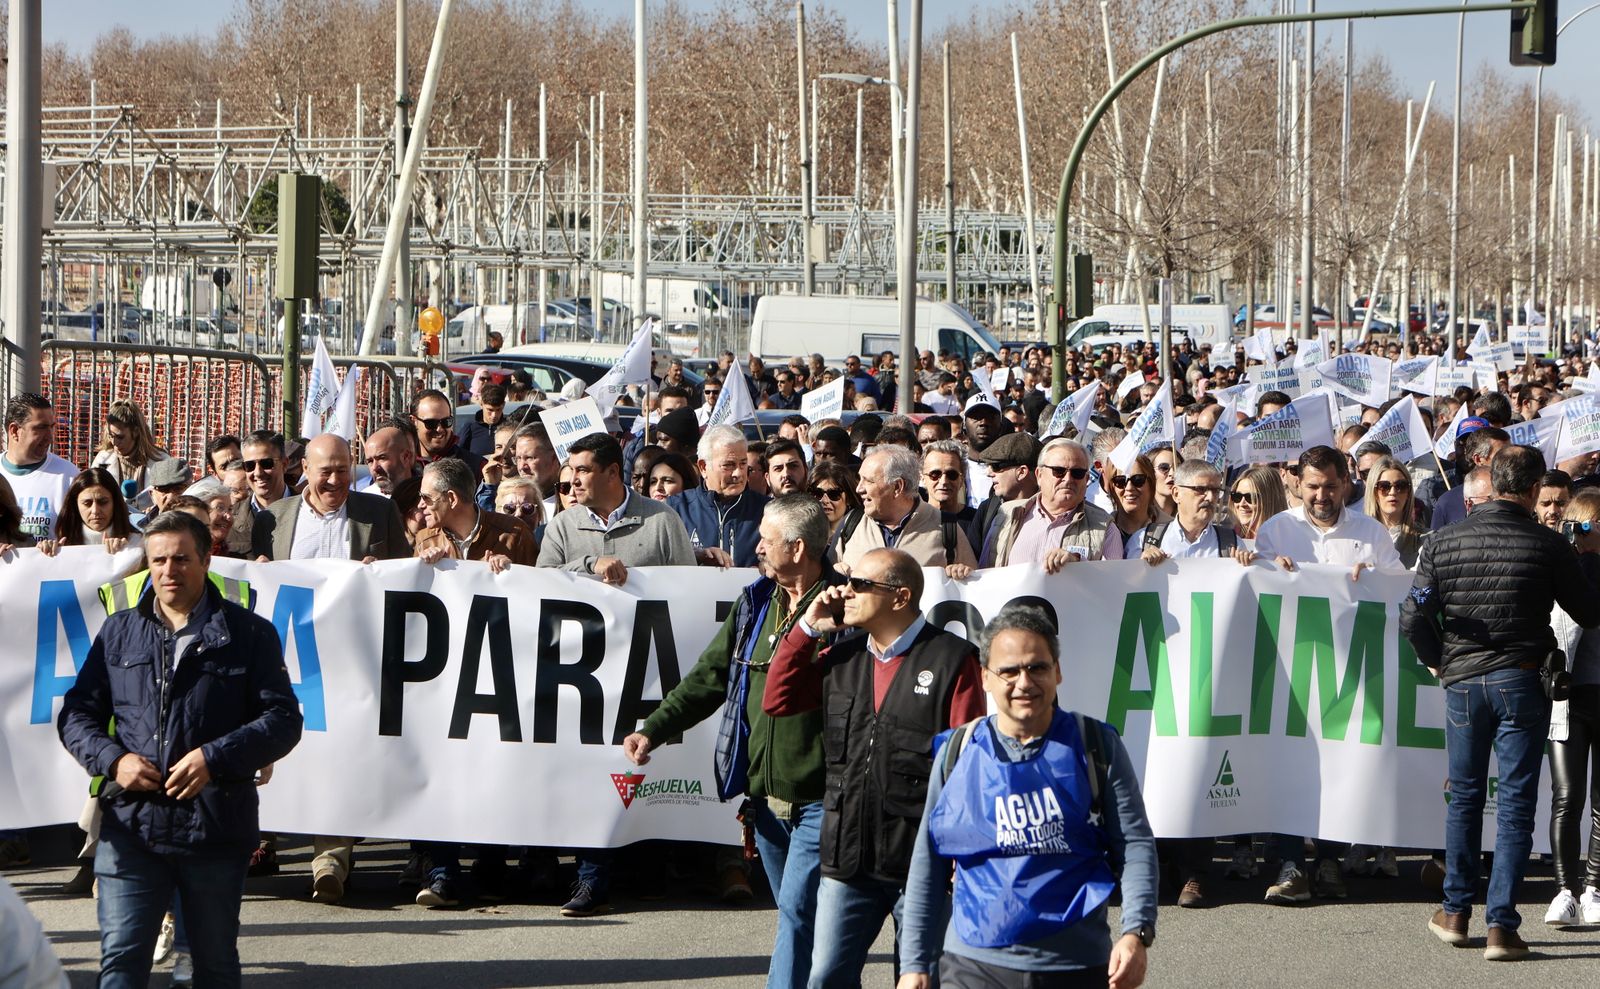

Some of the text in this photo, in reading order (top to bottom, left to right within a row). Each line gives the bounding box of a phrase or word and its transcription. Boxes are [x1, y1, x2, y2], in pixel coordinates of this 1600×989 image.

[1277, 367, 1295, 377] AGUA
[1264, 382, 1275, 391] HAY
[823, 390, 836, 404] AGUA
[573, 413, 592, 430] AGUA
[20, 497, 50, 516] UA
[379, 590, 683, 745] PARA
[914, 685, 929, 695] UPA
[626, 778, 703, 799] FRESHUELVA
[1206, 787, 1240, 799] ASAJA
[995, 787, 1064, 831] AGUA
[1210, 799, 1237, 808] HUELVA
[996, 829, 1029, 848] PARA
[1028, 820, 1065, 842] TODOS
